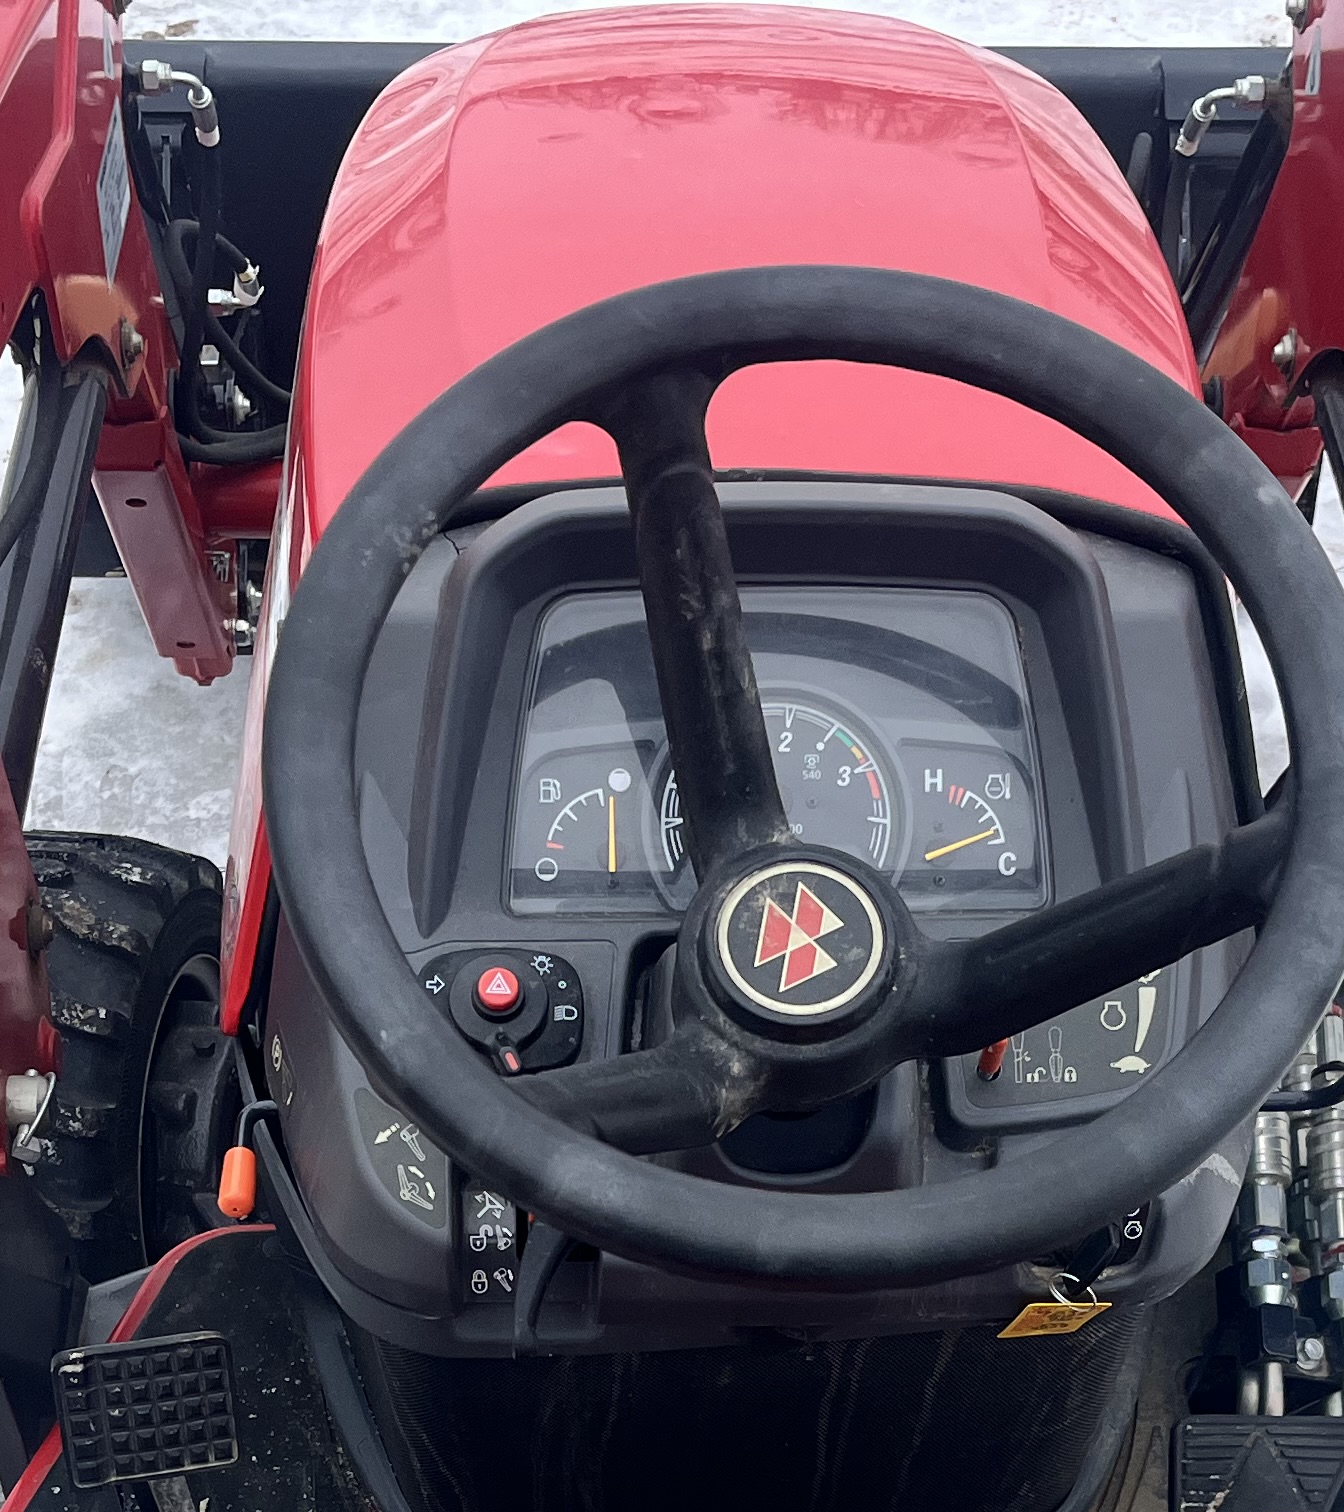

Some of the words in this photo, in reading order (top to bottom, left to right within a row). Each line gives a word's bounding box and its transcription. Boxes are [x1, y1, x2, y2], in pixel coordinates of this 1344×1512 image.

[778, 731, 793, 752] 2
[802, 769, 822, 780] 540
[836, 765, 852, 787] 3
[924, 768, 943, 792] H
[998, 852, 1017, 876] C
